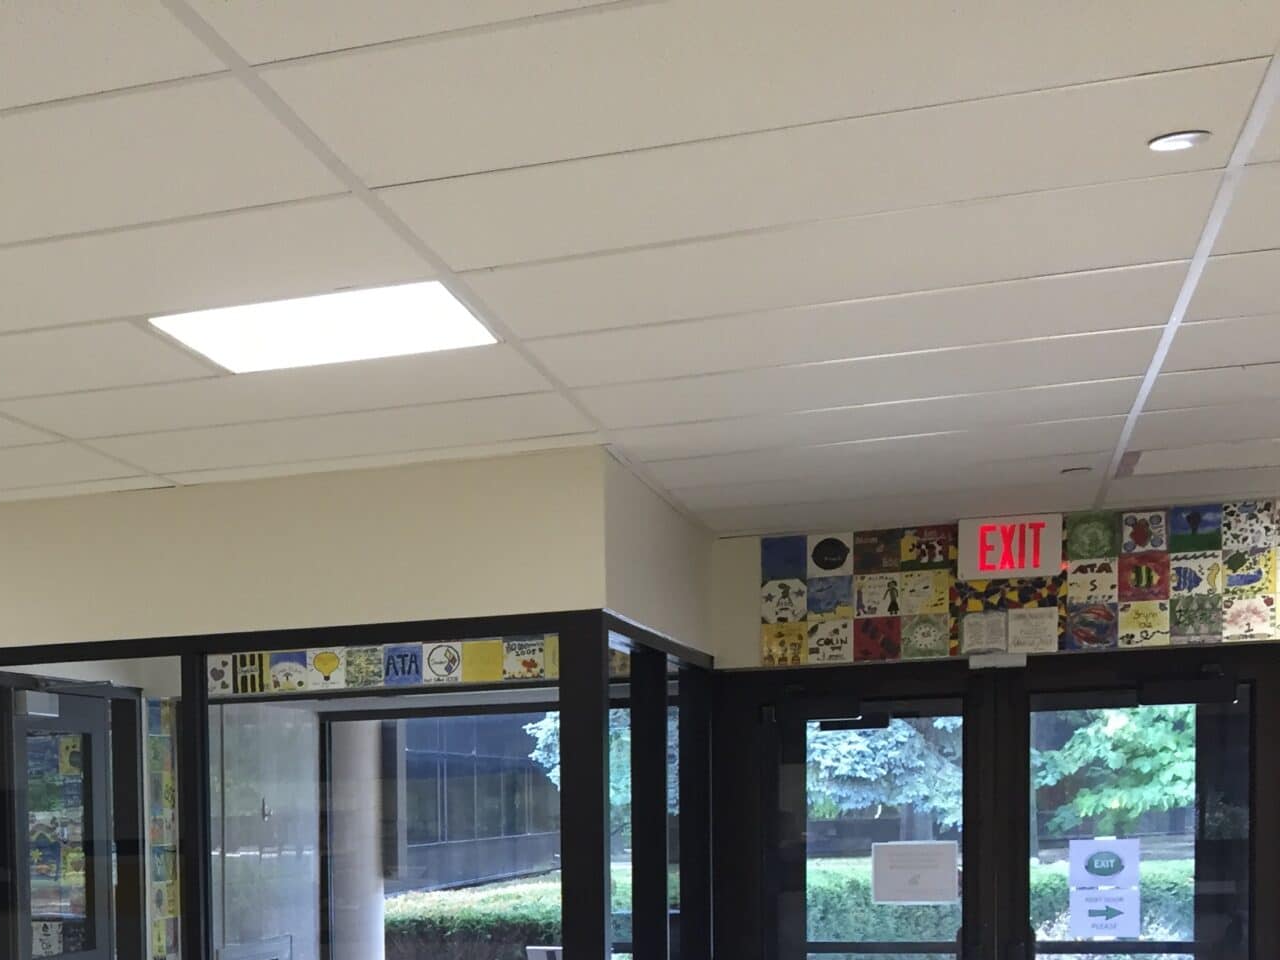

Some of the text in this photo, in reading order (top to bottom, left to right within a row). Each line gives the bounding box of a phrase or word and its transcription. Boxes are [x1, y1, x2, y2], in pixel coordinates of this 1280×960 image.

[978, 522, 1045, 572] EXIT
[385, 653, 419, 677] ATA
[1093, 859, 1116, 869] EXIT
